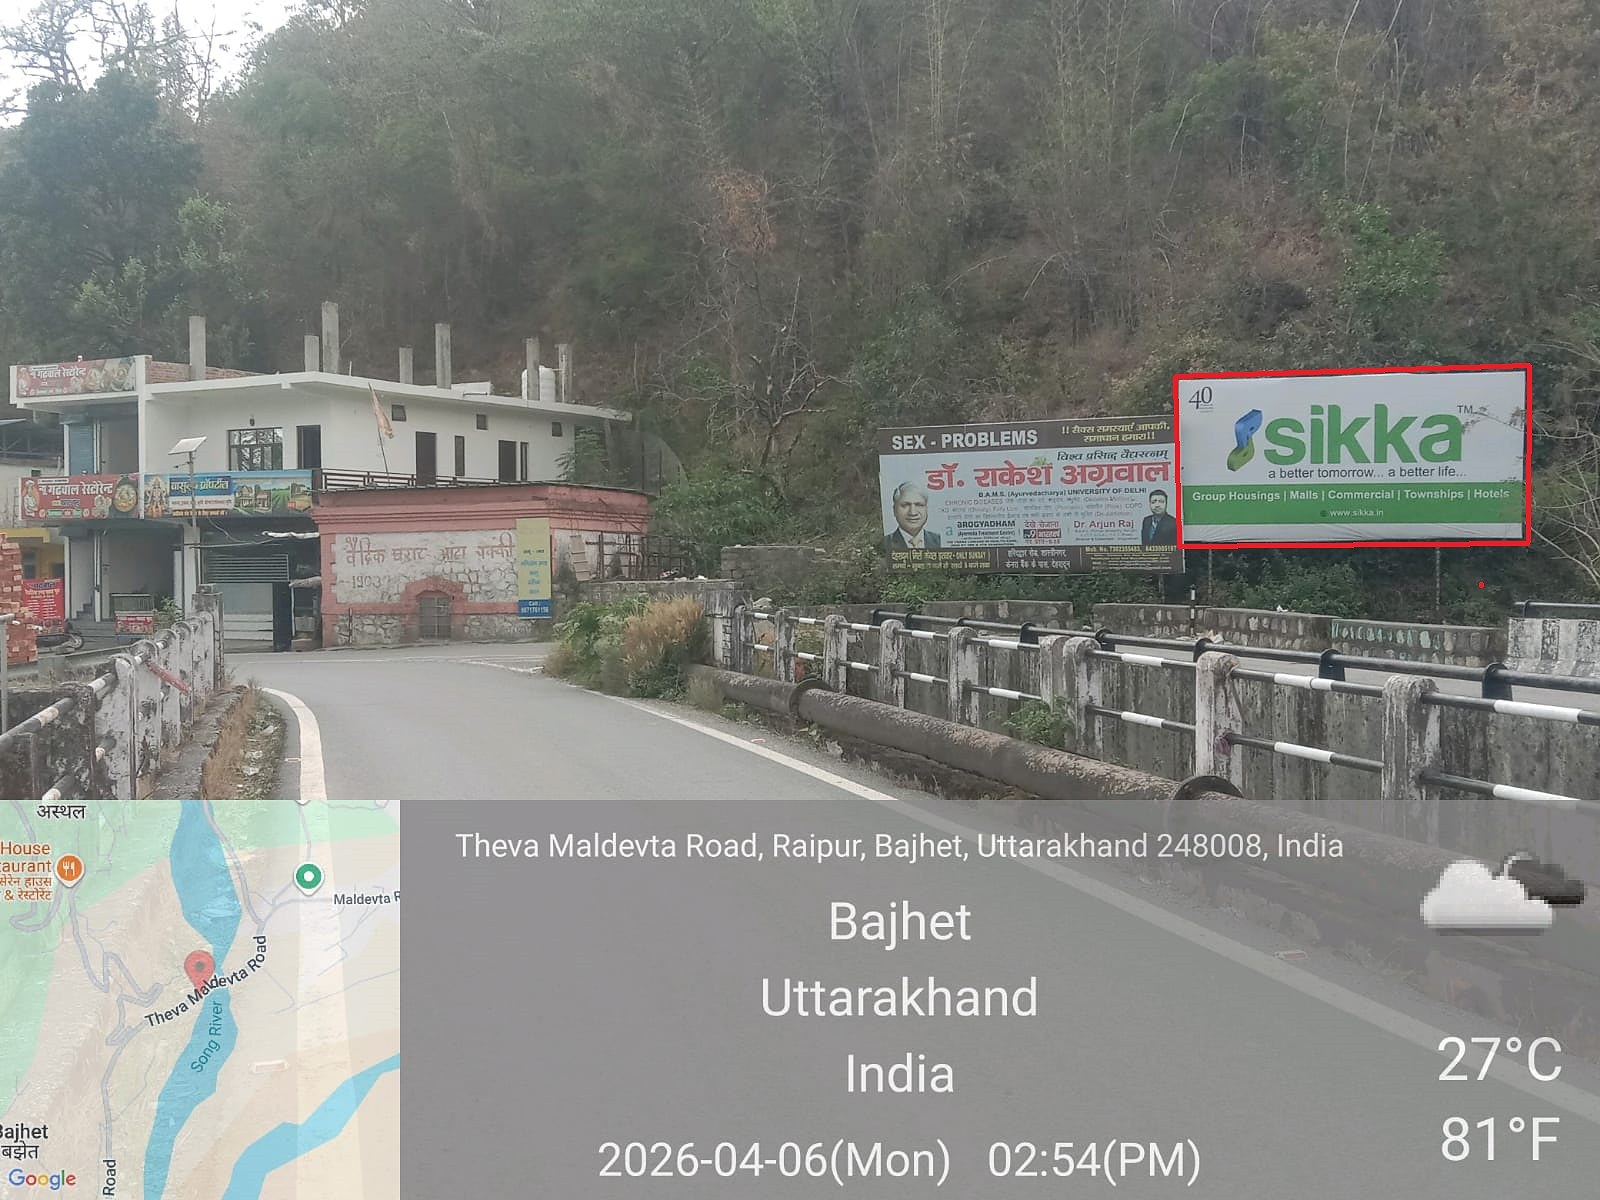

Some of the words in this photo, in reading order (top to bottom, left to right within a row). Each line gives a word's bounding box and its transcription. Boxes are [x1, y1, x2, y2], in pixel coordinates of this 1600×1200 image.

[1188, 386, 1212, 410] 40
[892, 435, 926, 450] SEX
[941, 429, 1038, 449] PROBLEMS
[1264, 404, 1462, 465] sikka
[925, 463, 965, 491] डॉ.
[973, 460, 1053, 488] राकेश
[1060, 461, 1171, 487] अग्रवाल
[1268, 470, 1276, 479] a
[1280, 468, 1314, 479] better
[1318, 467, 1384, 478] tomorrow...
[1388, 468, 1396, 477] a
[1400, 466, 1435, 477] better
[1438, 466, 1466, 477] life...
[1192, 491, 1226, 502] Group
[1229, 490, 1280, 502] Housings
[1290, 490, 1318, 500] Malls
[1328, 489, 1394, 500] Commercial
[1404, 488, 1464, 501] Townships
[1474, 488, 1510, 499] Hotels
[1329, 509, 1384, 517] www.sikka.in
[1089, 520, 1116, 530] Arjun
[1118, 519, 1134, 530] Raj
